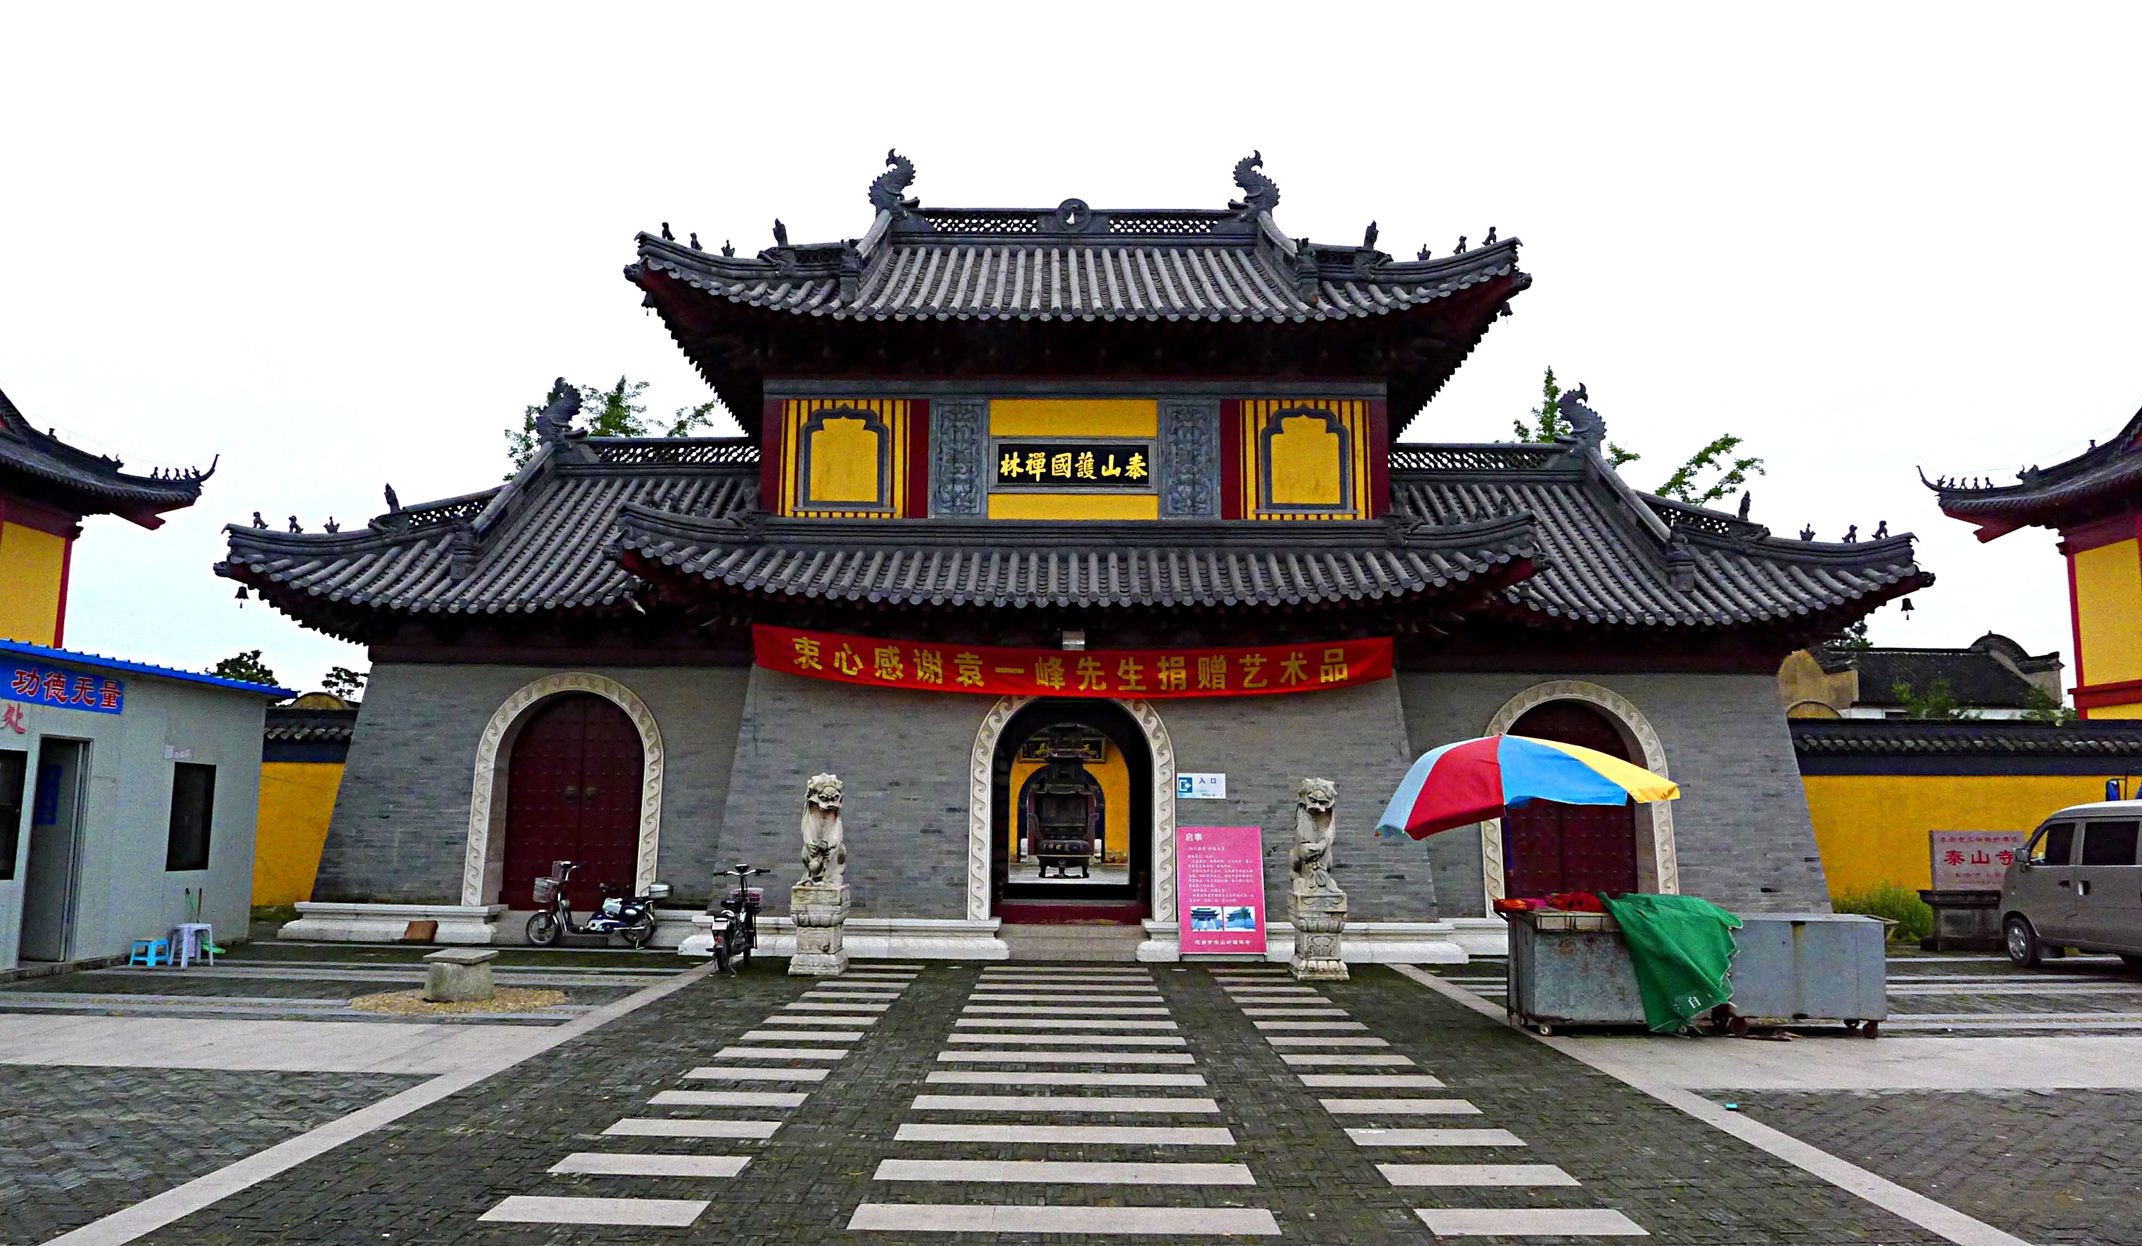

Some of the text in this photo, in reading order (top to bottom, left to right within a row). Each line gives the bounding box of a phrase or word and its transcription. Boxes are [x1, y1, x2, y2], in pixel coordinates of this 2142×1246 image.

[793, 636, 1350, 691] 衷心感谢袁一峰先生捐赠艺术品
[11, 667, 122, 708] 功德无量
[1944, 849, 2014, 866] 泰山寺
